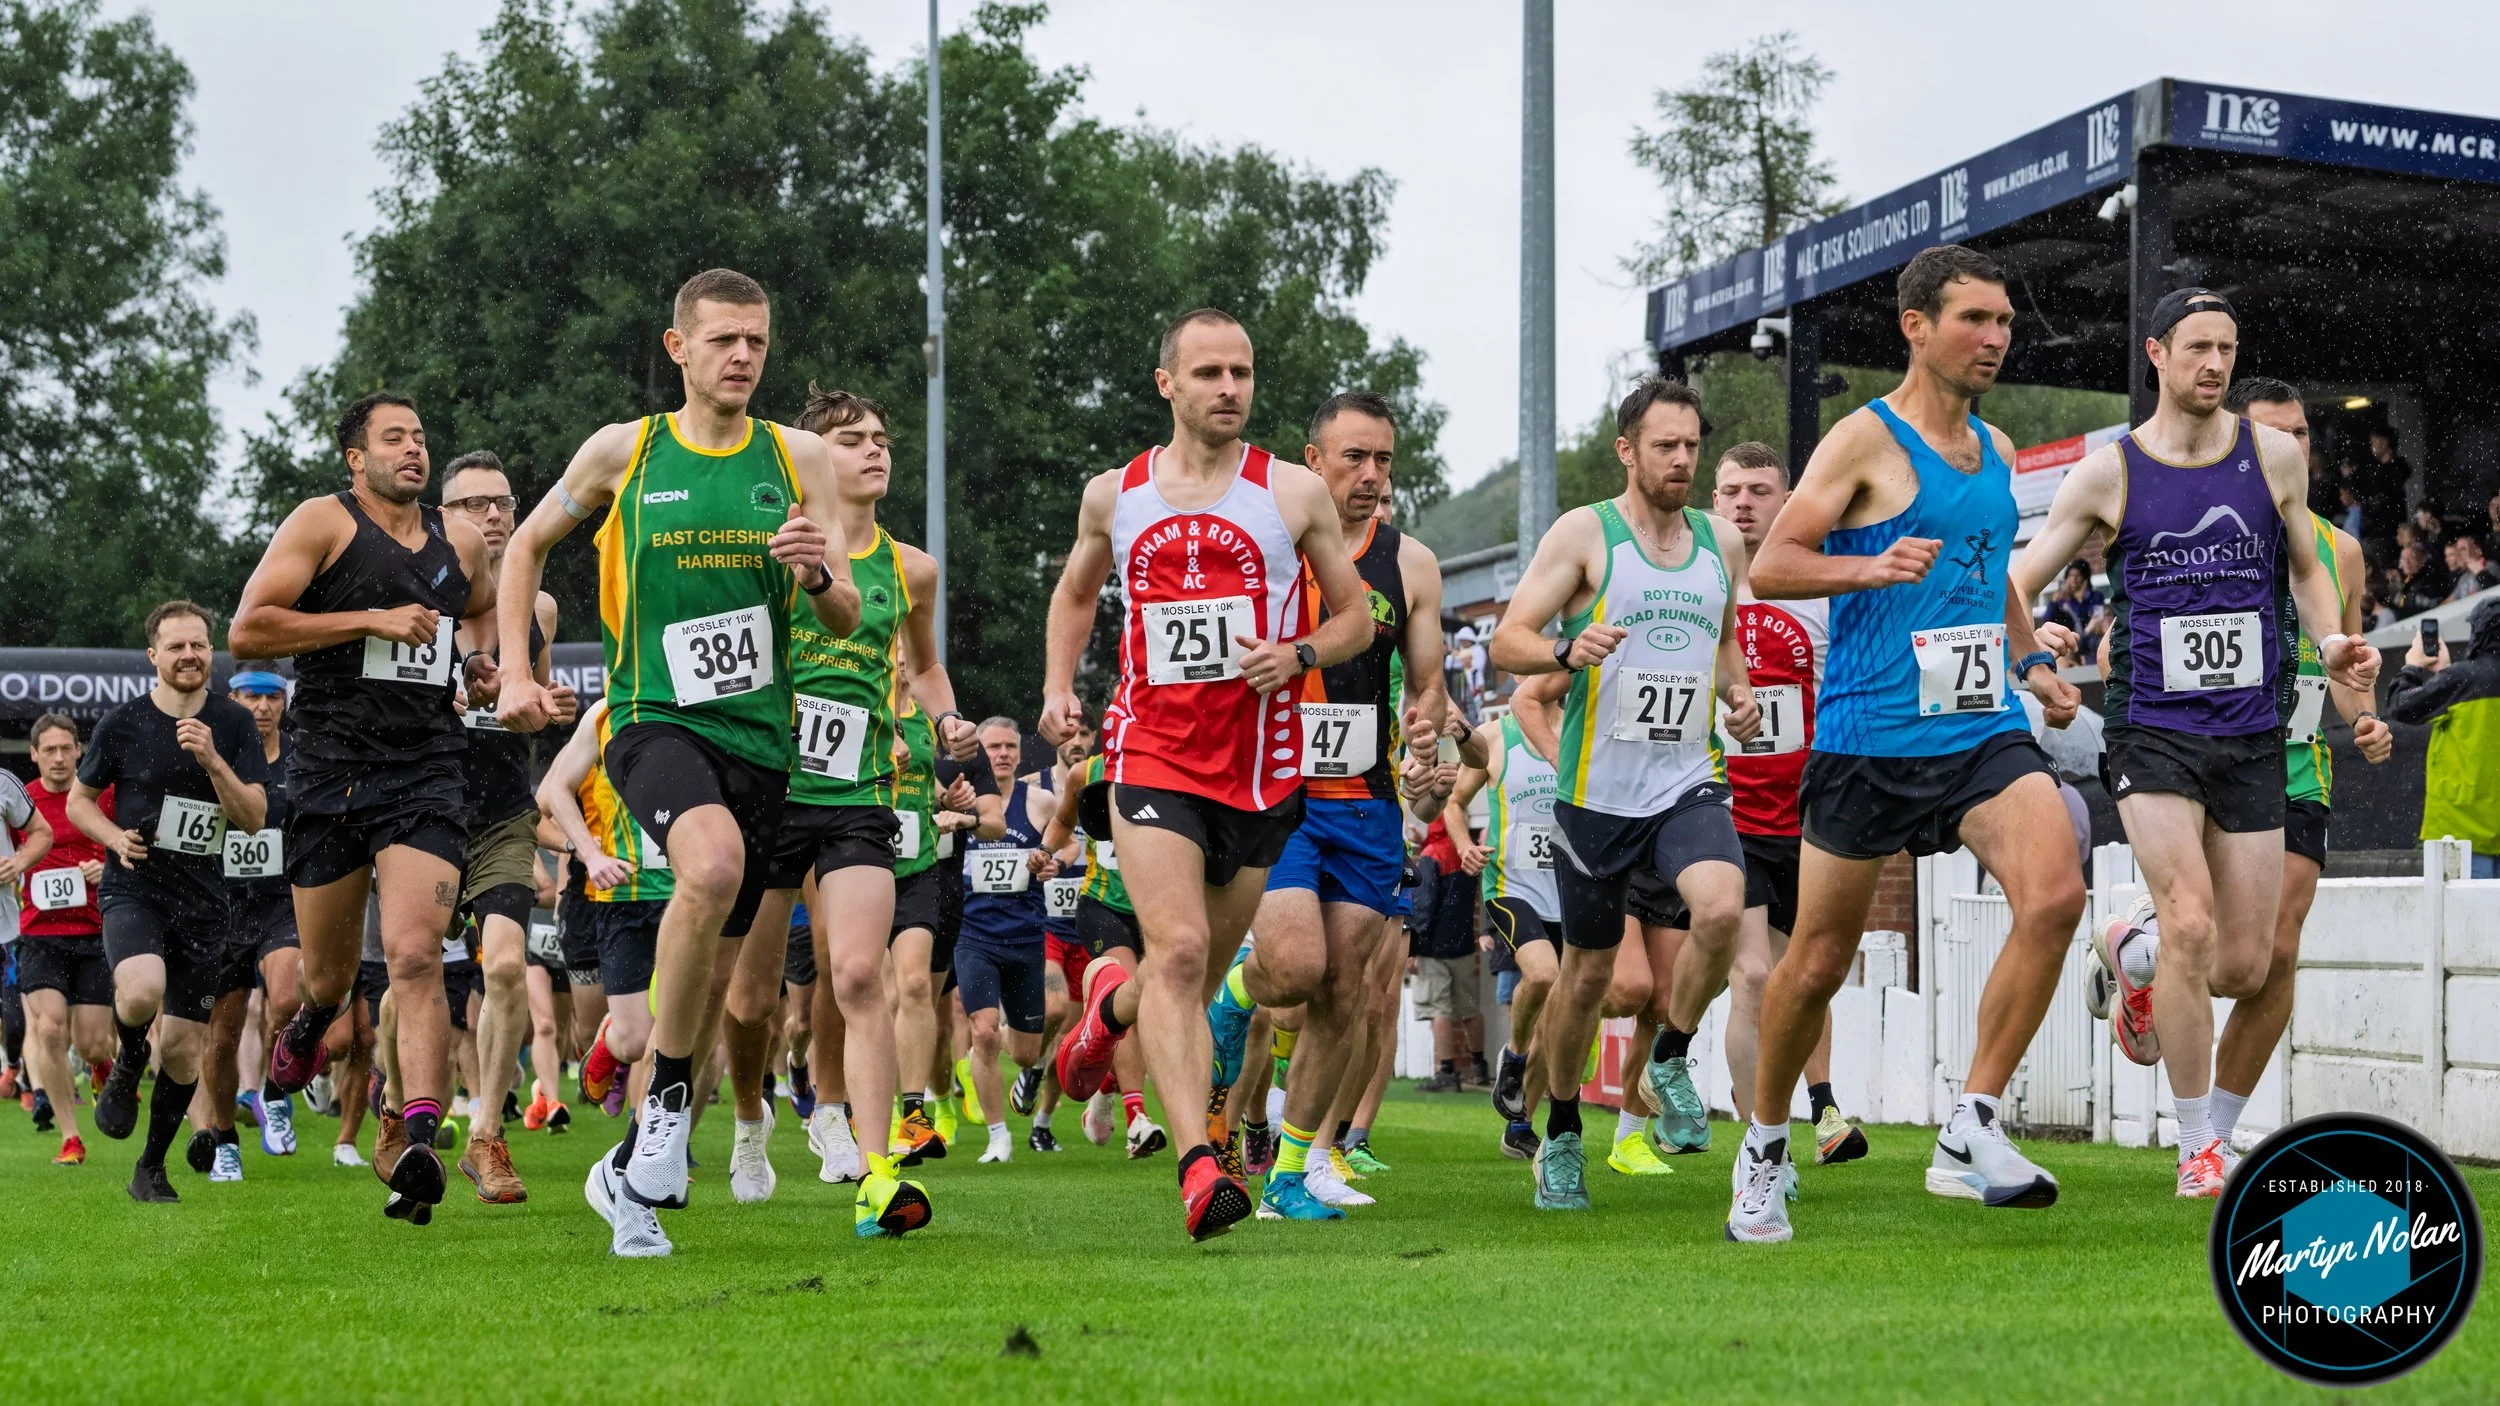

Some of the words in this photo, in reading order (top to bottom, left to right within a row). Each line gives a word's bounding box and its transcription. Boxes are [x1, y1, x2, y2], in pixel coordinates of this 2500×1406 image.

[2330, 119, 2500, 161] WWW.MCR
[1821, 240, 1845, 268] RISK
[1846, 210, 1908, 260] SOLUTIONS
[1910, 200, 1931, 237] LTD
[643, 489, 689, 505] ICON
[652, 530, 695, 548] EAST
[698, 529, 777, 546] CHESHIR
[1186, 540, 1199, 556] H
[1134, 522, 1182, 591] OLDHAM
[1187, 520, 1201, 537] &
[1206, 522, 1261, 590] ROYTON
[2144, 533, 2266, 568] moorside
[677, 554, 764, 570] HARRIERS
[1187, 556, 1200, 573] &
[1183, 573, 1206, 590] AC
[2156, 568, 2215, 587] racing
[2219, 567, 2261, 582] team
[1643, 589, 1704, 606] ROYTON
[1160, 603, 1211, 617] MOSSLEY
[1215, 601, 1235, 613] 10K
[681, 617, 733, 636] MOSSLEY
[734, 612, 755, 624] 10K
[1658, 608, 1719, 641] RUNNERS
[2179, 618, 2228, 628] MOSSLEY
[2229, 617, 2245, 626] 10K
[1165, 615, 1230, 663] 251
[1746, 612, 1758, 626] &
[1762, 614, 1808, 668] ROYTON
[1933, 629, 1982, 643] MOSSLEY
[689, 626, 759, 680] 384
[820, 635, 879, 660] CHESHIRE
[2182, 629, 2243, 671] 305
[799, 649, 861, 673] HARRIERS
[1951, 643, 1991, 691] 75
[1637, 672, 1682, 685] MOSSLEY
[1684, 676, 1698, 684] 10K
[1768, 688, 1785, 698] 10K
[795, 698, 834, 713] OSSLEY
[836, 706, 852, 717] 10K
[1299, 707, 1344, 717] MOSSLEY
[1346, 708, 1361, 717] 10K
[1636, 685, 1696, 726] 217
[1311, 720, 1351, 758] 47
[1528, 774, 1558, 784] ROYT
[1510, 786, 1537, 805] ROAD
[177, 801, 211, 813] MOSSLEY
[176, 811, 220, 843] 165
[230, 840, 270, 866] 360
[983, 860, 1019, 882] 257
[44, 877, 74, 899] 130
[540, 932, 559, 950] 13
